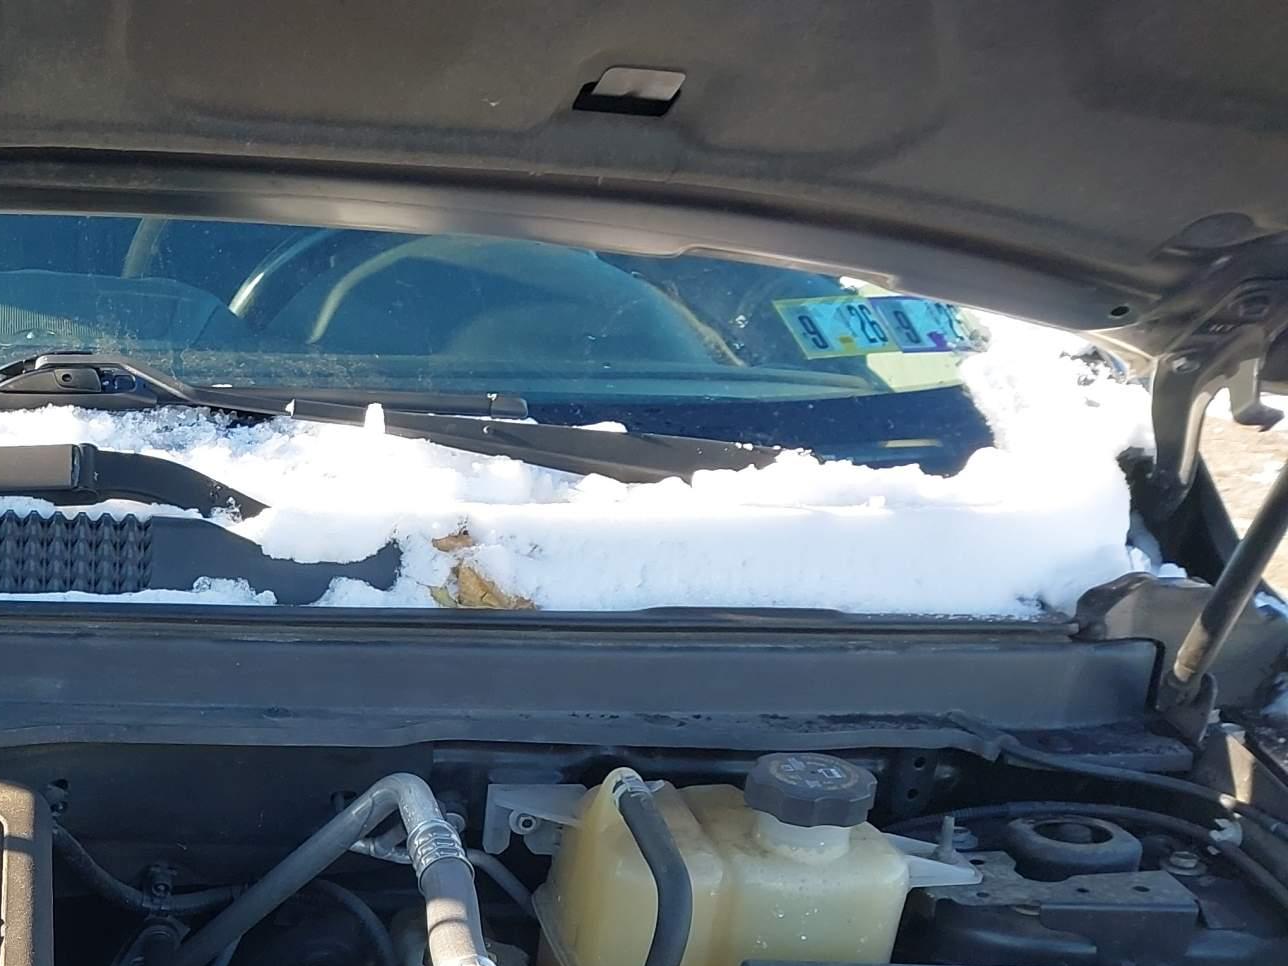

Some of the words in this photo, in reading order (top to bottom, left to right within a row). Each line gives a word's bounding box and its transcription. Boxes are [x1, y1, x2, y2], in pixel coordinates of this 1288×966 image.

[797, 314, 829, 350] 9
[846, 304, 889, 344] 26
[893, 309, 923, 345] 9
